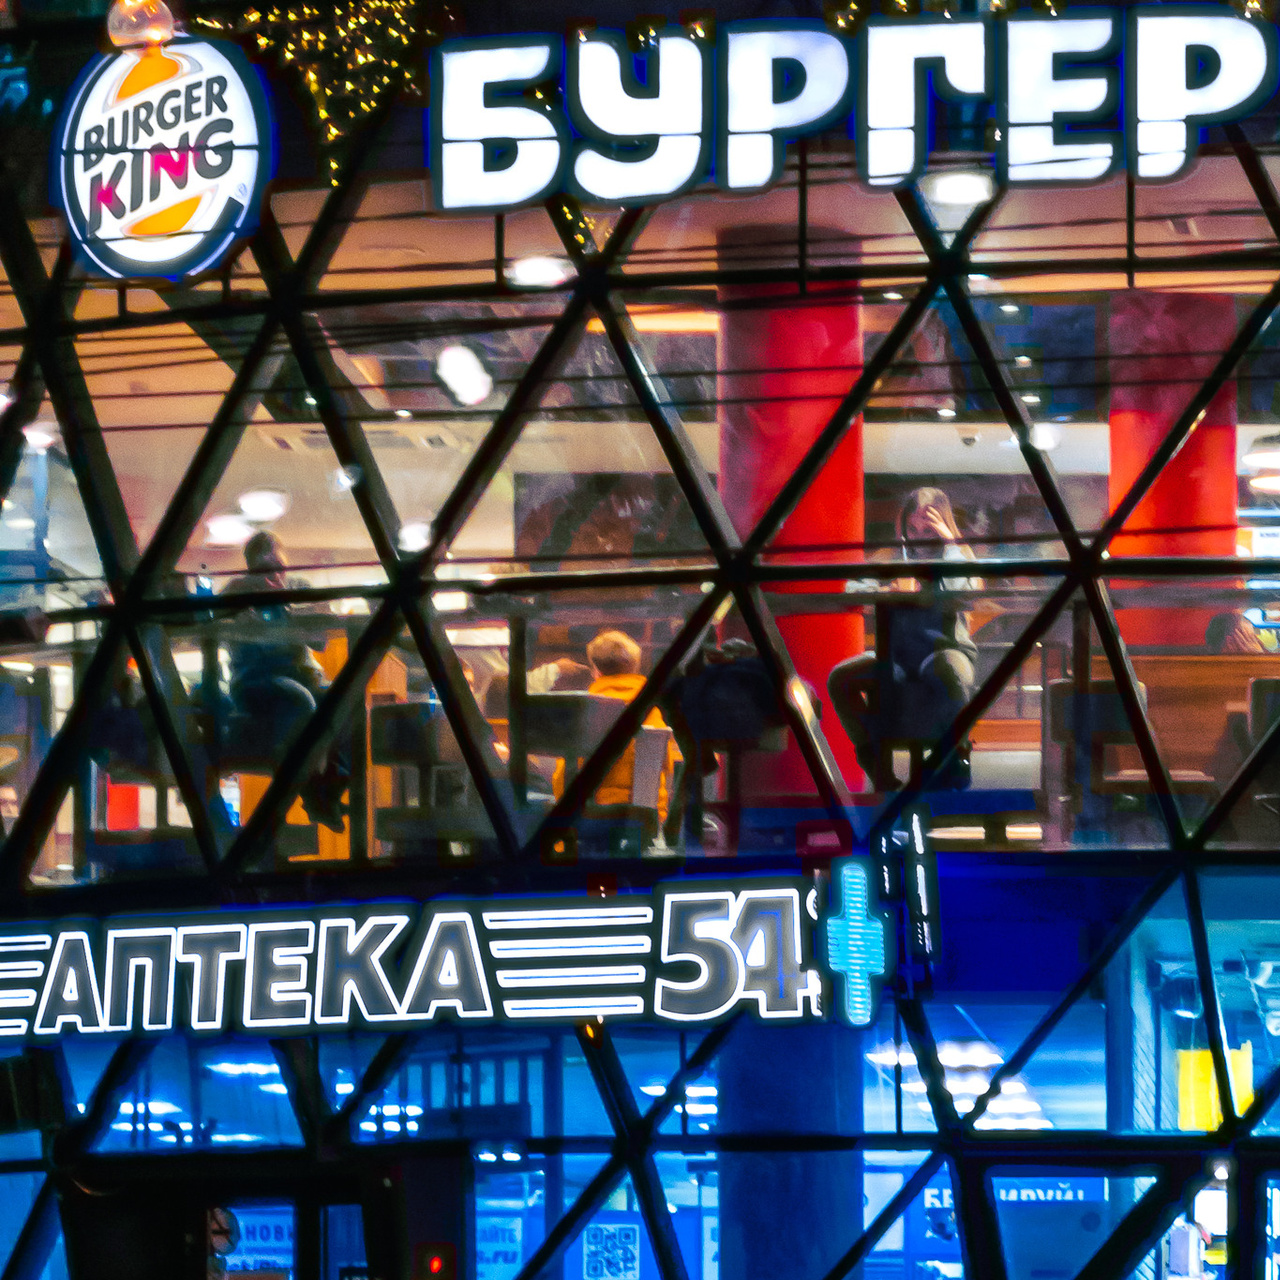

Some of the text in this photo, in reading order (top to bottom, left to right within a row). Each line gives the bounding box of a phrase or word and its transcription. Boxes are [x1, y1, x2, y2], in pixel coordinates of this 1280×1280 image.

[84, 75, 227, 172] BURGER
[88, 118, 234, 235] KING
[442, 16, 1267, 208] БУРГЕР
[34, 888, 809, 1034] АПТЕКА 54
